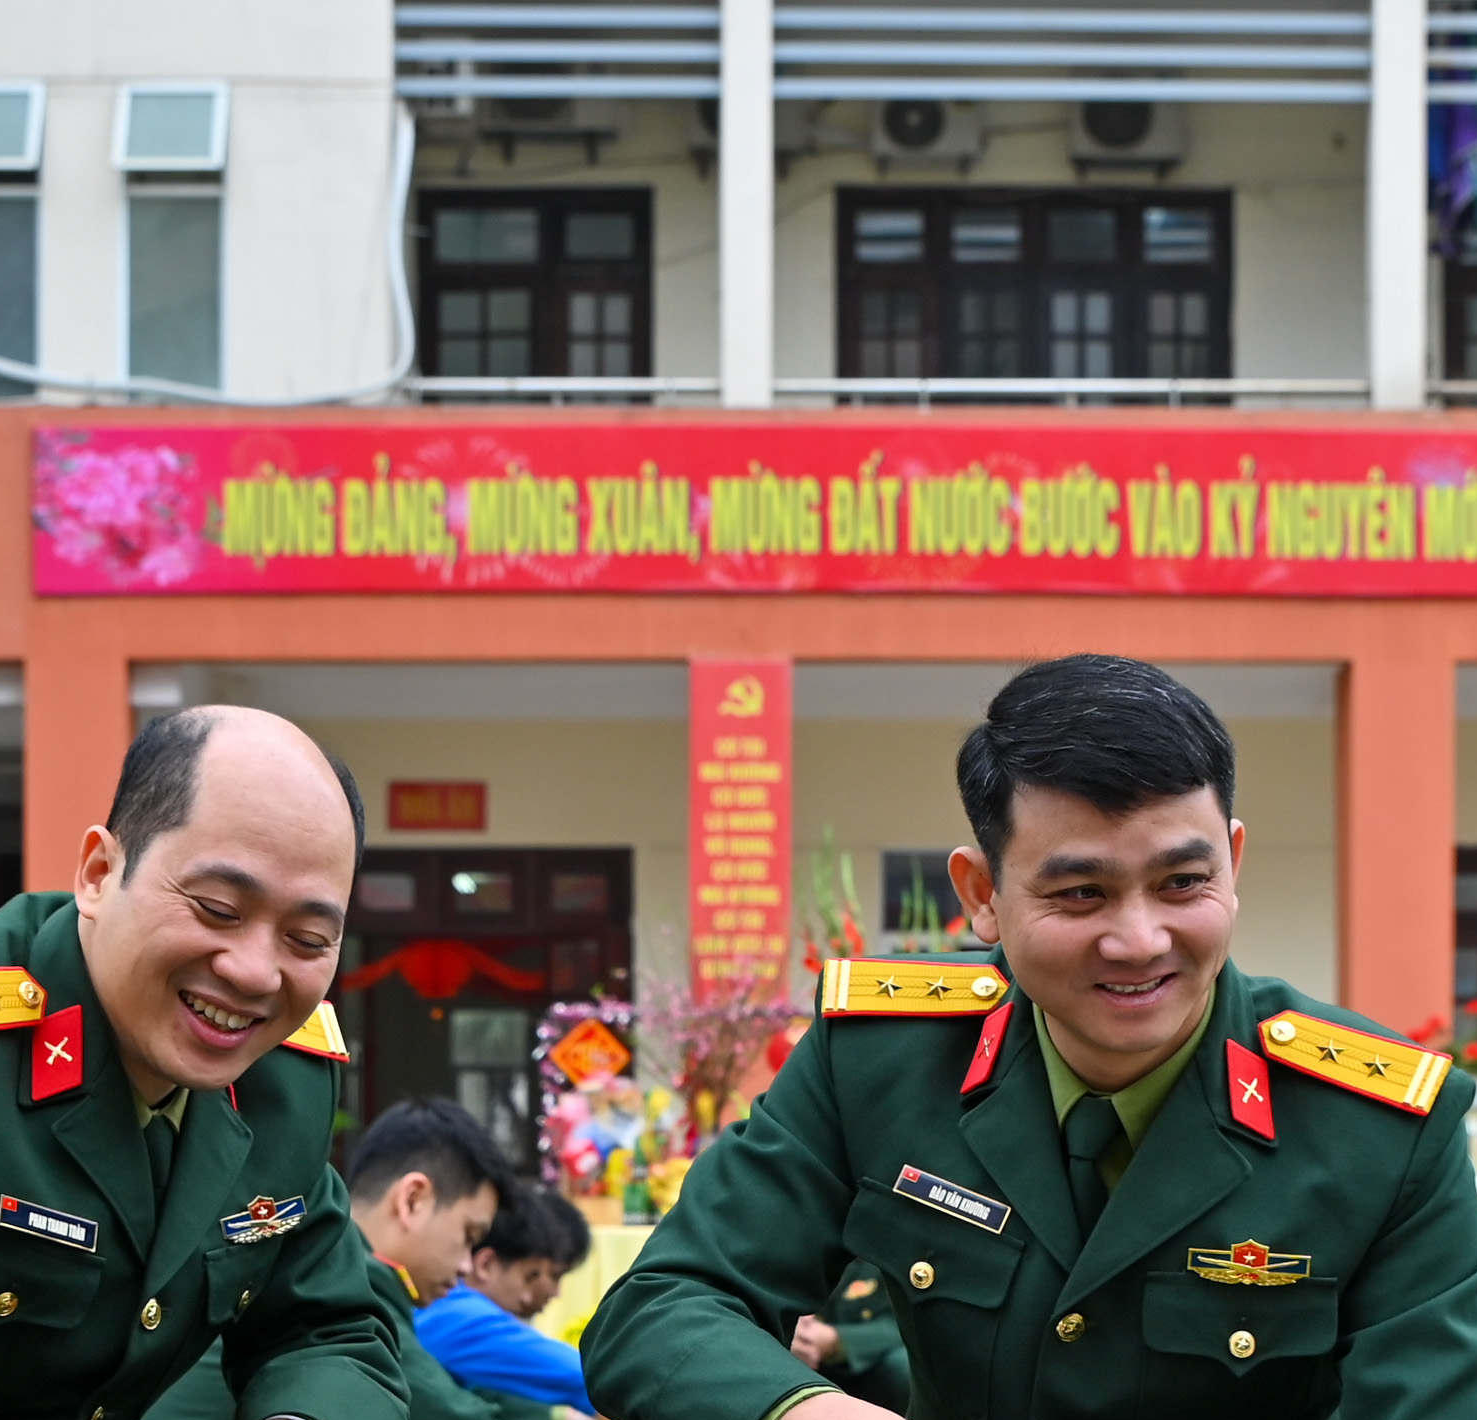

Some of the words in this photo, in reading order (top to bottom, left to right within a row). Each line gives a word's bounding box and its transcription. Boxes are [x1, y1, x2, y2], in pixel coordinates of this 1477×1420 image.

[223, 461, 336, 557] MỪNG
[343, 451, 459, 564] ĐẢNG,
[466, 461, 579, 557] MỪNG
[586, 459, 702, 565] XUÂN,
[709, 459, 822, 556] MỪNG
[829, 448, 902, 556] ĐẤT
[909, 459, 1012, 557] NƯỚC
[1019, 461, 1121, 558] BƯỚC
[1126, 462, 1203, 559] VÀO
[1208, 453, 1261, 560] KỶ
[1265, 465, 1416, 561] NGUYÊN
[945, 1191, 962, 1208] VĂN
